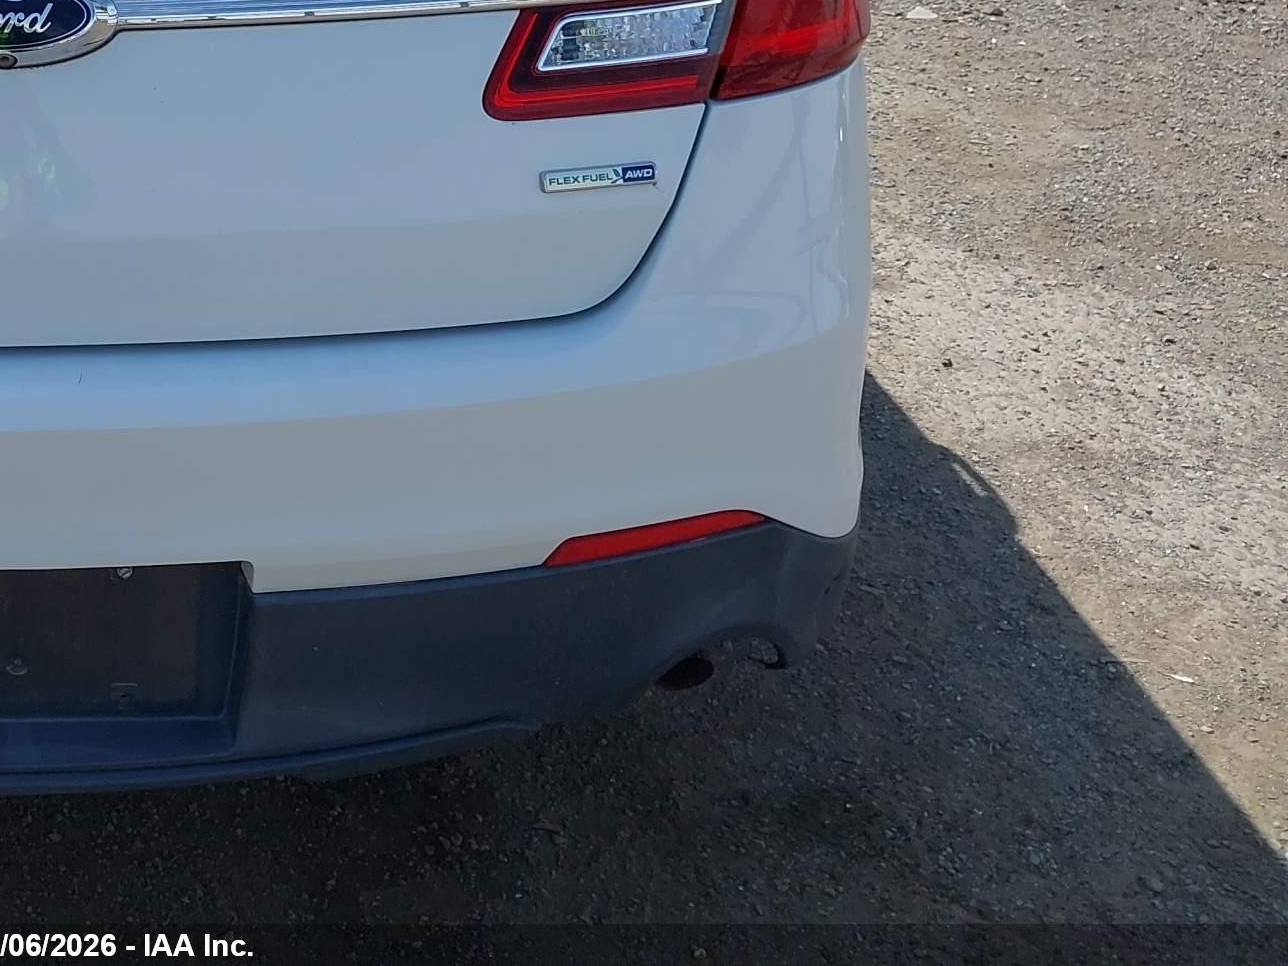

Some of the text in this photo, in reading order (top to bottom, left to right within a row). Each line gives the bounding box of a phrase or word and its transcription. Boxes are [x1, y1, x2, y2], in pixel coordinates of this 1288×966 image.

[548, 168, 653, 186] FLEX FUEL AWD
